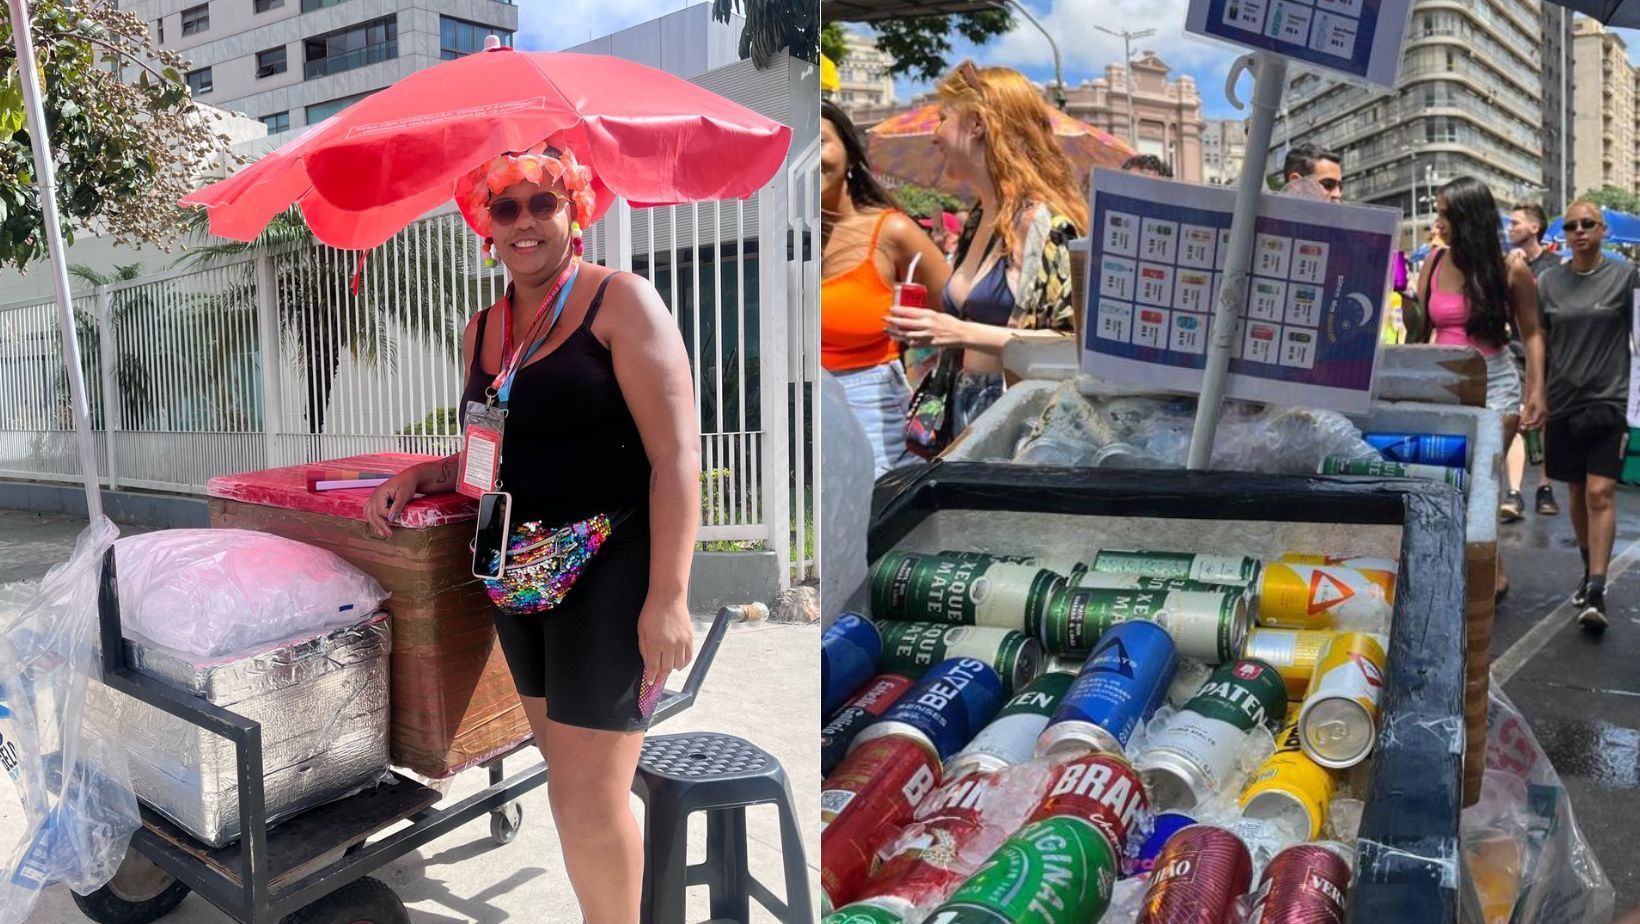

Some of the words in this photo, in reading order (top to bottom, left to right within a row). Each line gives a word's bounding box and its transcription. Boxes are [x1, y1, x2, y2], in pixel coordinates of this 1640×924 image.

[927, 562, 956, 613] MATE
[947, 562, 977, 621] XEQUE
[915, 623, 948, 665] EQUE
[918, 657, 984, 713] BEATS
[1196, 680, 1270, 727] PATEN
[1019, 822, 1073, 924] RIGINAL
